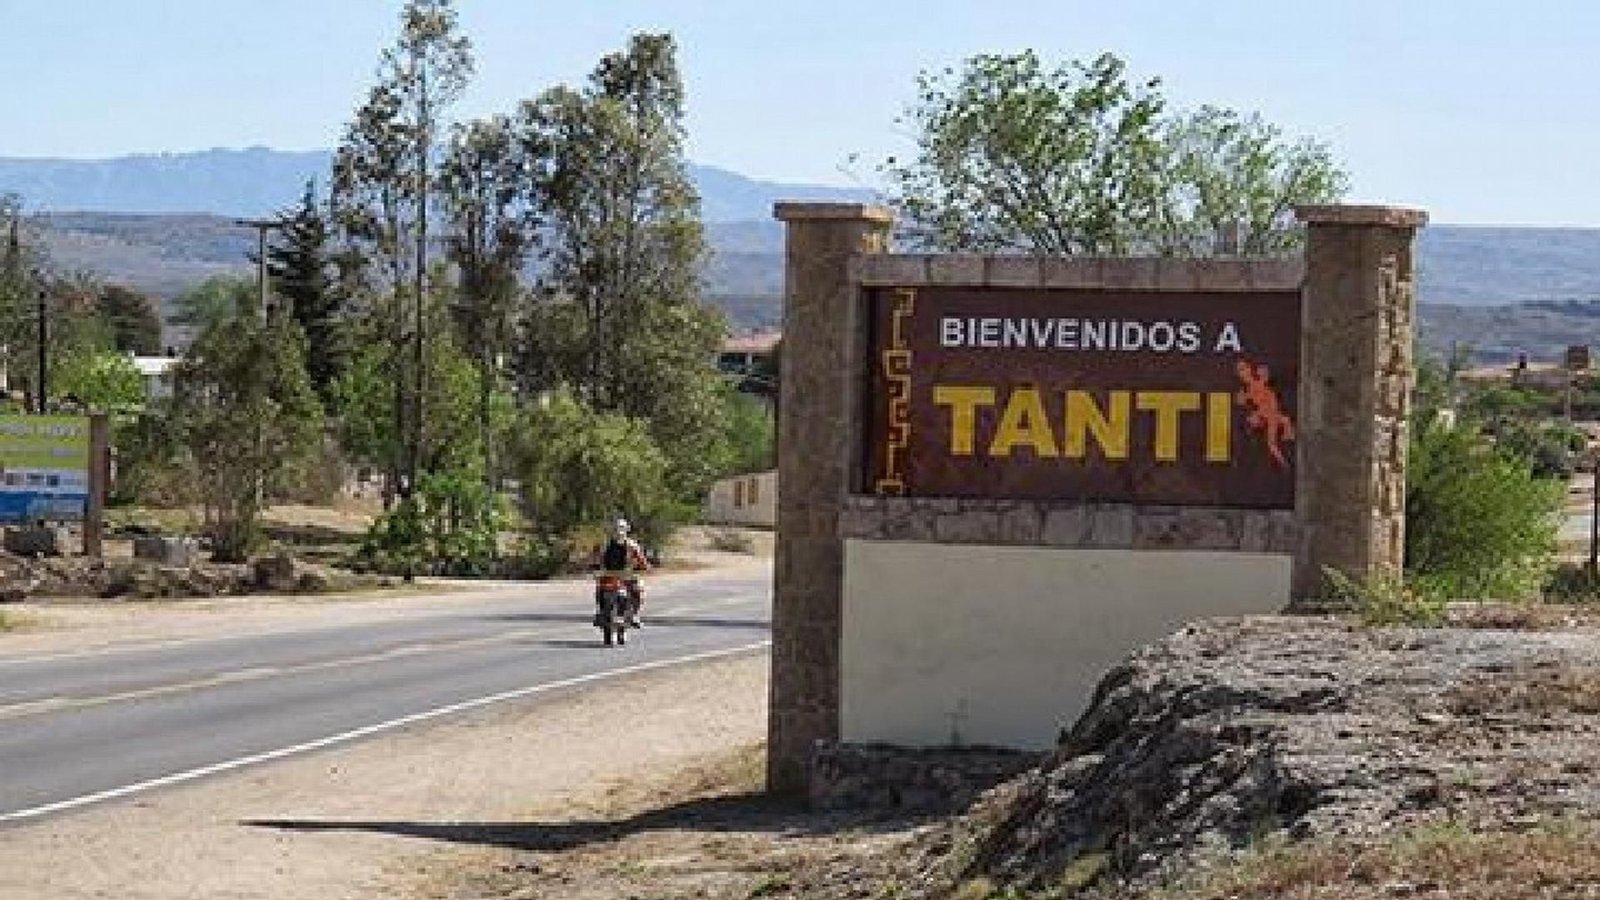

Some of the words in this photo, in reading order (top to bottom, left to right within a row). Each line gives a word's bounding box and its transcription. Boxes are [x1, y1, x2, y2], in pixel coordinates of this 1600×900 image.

[941, 317, 1202, 352] BIENVENIDOS
[1215, 322, 1242, 351] A
[934, 386, 1232, 461] TANTI
